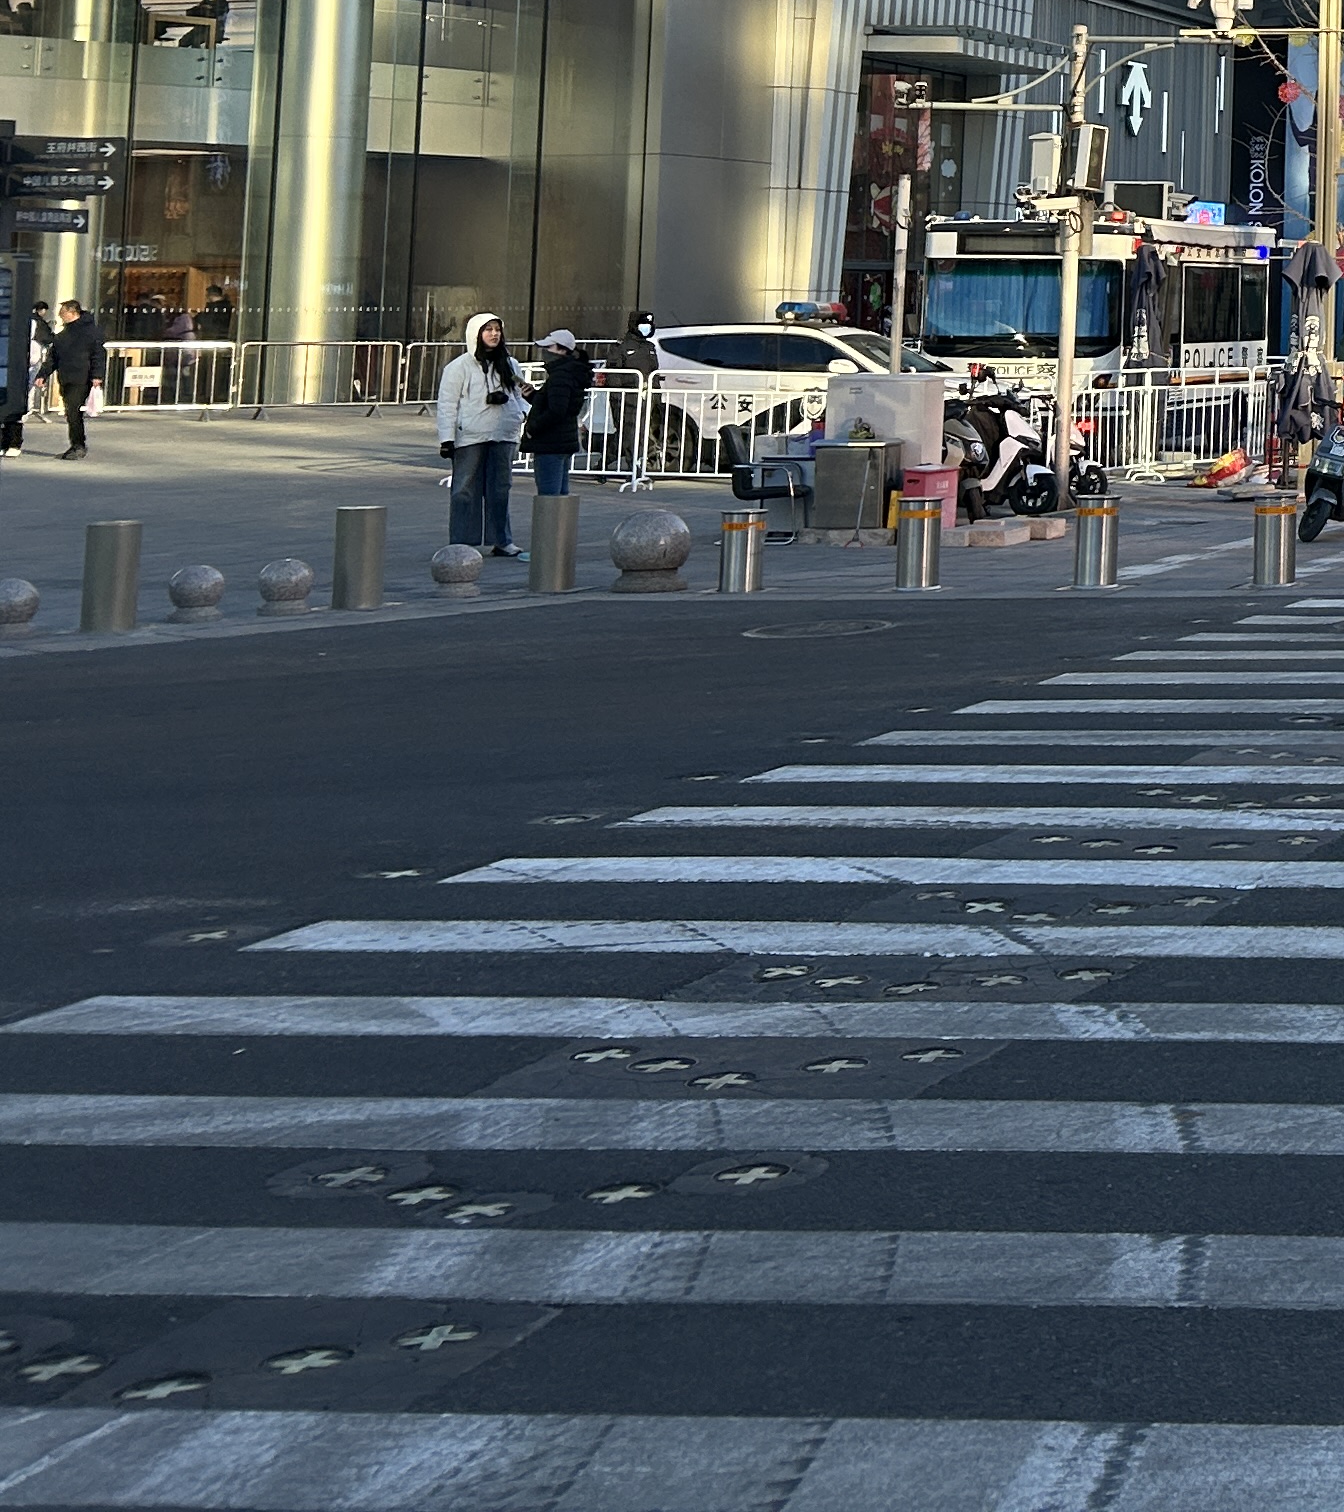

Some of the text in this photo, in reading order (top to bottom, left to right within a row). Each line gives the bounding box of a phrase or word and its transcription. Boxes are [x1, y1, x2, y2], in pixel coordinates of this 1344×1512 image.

[1248, 159, 1265, 215] KOLON
[1184, 346, 1234, 368] POLICE
[990, 365, 1034, 375] OLICE
